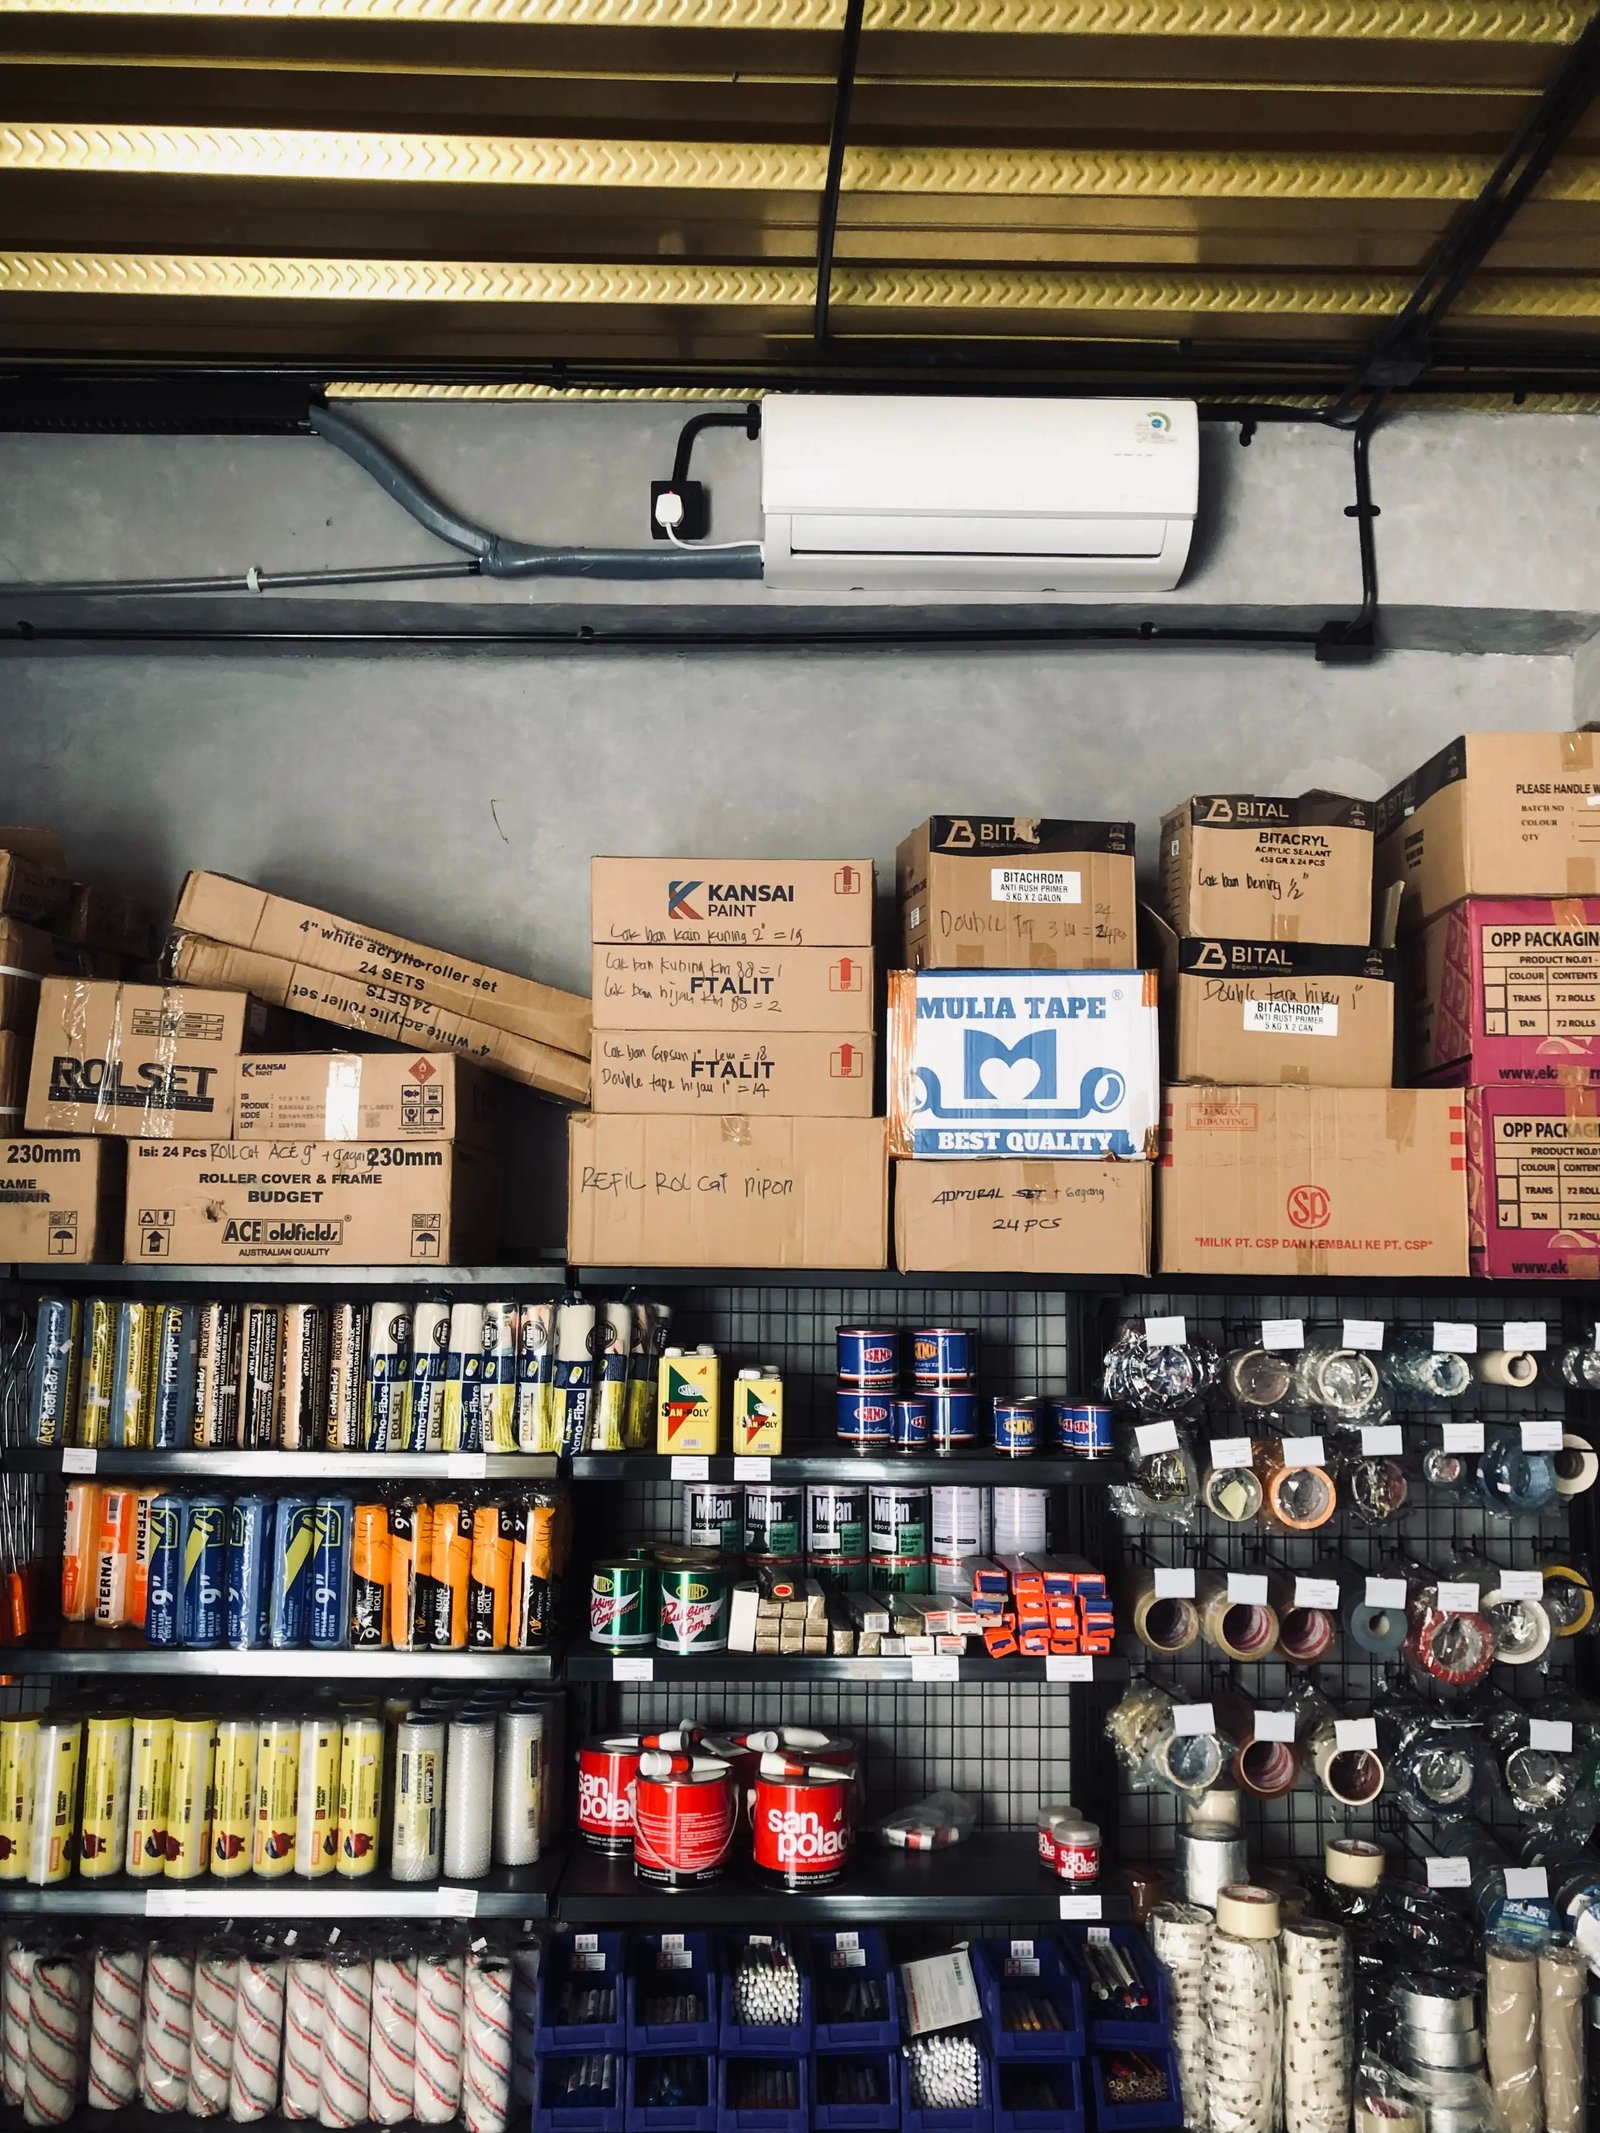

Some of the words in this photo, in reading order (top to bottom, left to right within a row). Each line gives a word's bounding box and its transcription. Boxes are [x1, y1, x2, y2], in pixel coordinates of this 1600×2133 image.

[1516, 784, 1551, 794] PLEASE
[1553, 784, 1590, 794] HANDLE
[1237, 802, 1289, 818] BITAL
[1259, 832, 1328, 847] BITACRYL
[1255, 846, 1290, 855] ACRYLIC
[1293, 849, 1332, 858] SEALANT
[1004, 872, 1063, 884] BITACHROM
[708, 885, 794, 902] KANSAI
[1013, 893, 1022, 901] KG
[1038, 894, 1062, 902] GALON
[1019, 884, 1038, 892] RUSH
[1041, 885, 1068, 893] PRIMER
[708, 904, 756, 917] PAINT
[1491, 932, 1521, 947] OPP
[321, 928, 364, 949] white
[426, 961, 470, 984] roller
[472, 976, 499, 993] set
[1231, 947, 1293, 965] BITAL
[1519, 956, 1564, 964] PRODUCT
[357, 961, 378, 977] 24
[381, 967, 426, 991] SETS
[1509, 972, 1544, 980] COLOUR
[1553, 971, 1598, 980] CONTENTS
[291, 984, 319, 1000] set
[365, 983, 413, 1006] SETS
[691, 977, 774, 994] FTALIT
[321, 992, 367, 1015] roller
[916, 996, 1017, 1019] MULIA
[1024, 996, 1106, 1019] TAPE
[1513, 994, 1541, 1002] TRANS
[1556, 994, 1566, 1002] 72
[1568, 994, 1595, 1002] ROLLS
[1257, 1002, 1320, 1015] BITACHROM
[369, 1006, 422, 1031] acrylic
[1254, 1013, 1272, 1021] ANTI
[1273, 1014, 1293, 1022] RUST
[1295, 1016, 1324, 1024] PRIMER
[1298, 1024, 1314, 1032] CAN
[1518, 1019, 1535, 1027] TAN
[1556, 1019, 1567, 1027] 72
[1568, 1019, 1596, 1027] ROLLS
[426, 1026, 469, 1048] white
[50, 1056, 218, 1098] ROLSET
[691, 1061, 775, 1078] FTALIT
[1503, 1122, 1532, 1138] OPP
[138, 1145, 159, 1157] Isi:
[163, 1145, 179, 1158] 24
[183, 1146, 207, 1158] Pcs
[938, 1132, 1000, 1150] BEST
[1006, 1132, 1112, 1152] QUALITY
[1531, 1147, 1574, 1155] PRODUCT
[7, 1144, 80, 1163] 230mm
[366, 1147, 443, 1166] 230mm
[1521, 1164, 1556, 1172] COLOUR
[199, 1173, 257, 1184] ROLLER
[261, 1173, 312, 1184] COVER
[316, 1173, 327, 1184] &
[331, 1173, 382, 1185] FRAME
[248, 1191, 324, 1203] BUDGET
[1567, 1187, 1577, 1195] 72
[993, 1219, 1018, 1230] 24
[1024, 1218, 1063, 1233] PCS
[1531, 1212, 1548, 1220] TAN
[1568, 1212, 1578, 1221] 72
[224, 1220, 261, 1242] ACE
[268, 1221, 339, 1243] oldfields
[239, 1248, 292, 1257] AUSTRALIAN
[293, 1248, 330, 1257] QUALITY
[1195, 1237, 1232, 1248] "MILIK
[1235, 1239, 1253, 1248] PT.
[1256, 1239, 1279, 1248] CSP
[1282, 1239, 1306, 1249] DAN
[1309, 1239, 1362, 1250] KEMBALI
[1365, 1240, 1382, 1249] KE
[441, 1322, 449, 1344] EPOXY
[197, 1368, 206, 1414] oldfields
[330, 1369, 339, 1414] oldfields
[375, 1384, 390, 1450] Nano-Fibre
[390, 1391, 402, 1441] ROLSET
[415, 1384, 430, 1451] Nano-Fibre
[431, 1390, 443, 1439] ROLSET
[467, 1385, 480, 1449] Nano-Fibre
[661, 1402, 710, 1417] SAN-POLY
[193, 1417, 204, 1442] ACE
[327, 1417, 338, 1444] ACE
[570, 1392, 586, 1456] Nano-Fibre
[695, 1496, 732, 1519] Milan
[137, 1499, 148, 1561] ETERNA
[98, 1555, 113, 1619] ETERNA
[151, 1575, 174, 1606] 9"
[200, 1574, 222, 1604] 9"
[315, 1573, 337, 1604] 9"
[374, 1589, 382, 1611] ROLL
[484, 1591, 492, 1614] ROLL
[207, 1611, 215, 1637] ROLLER
[328, 1613, 336, 1637] COVER
[476, 1621, 492, 1640] 9"
[578, 1770, 609, 1798] san
[768, 1808, 819, 1835] san
[1060, 1850, 1085, 1862] san
